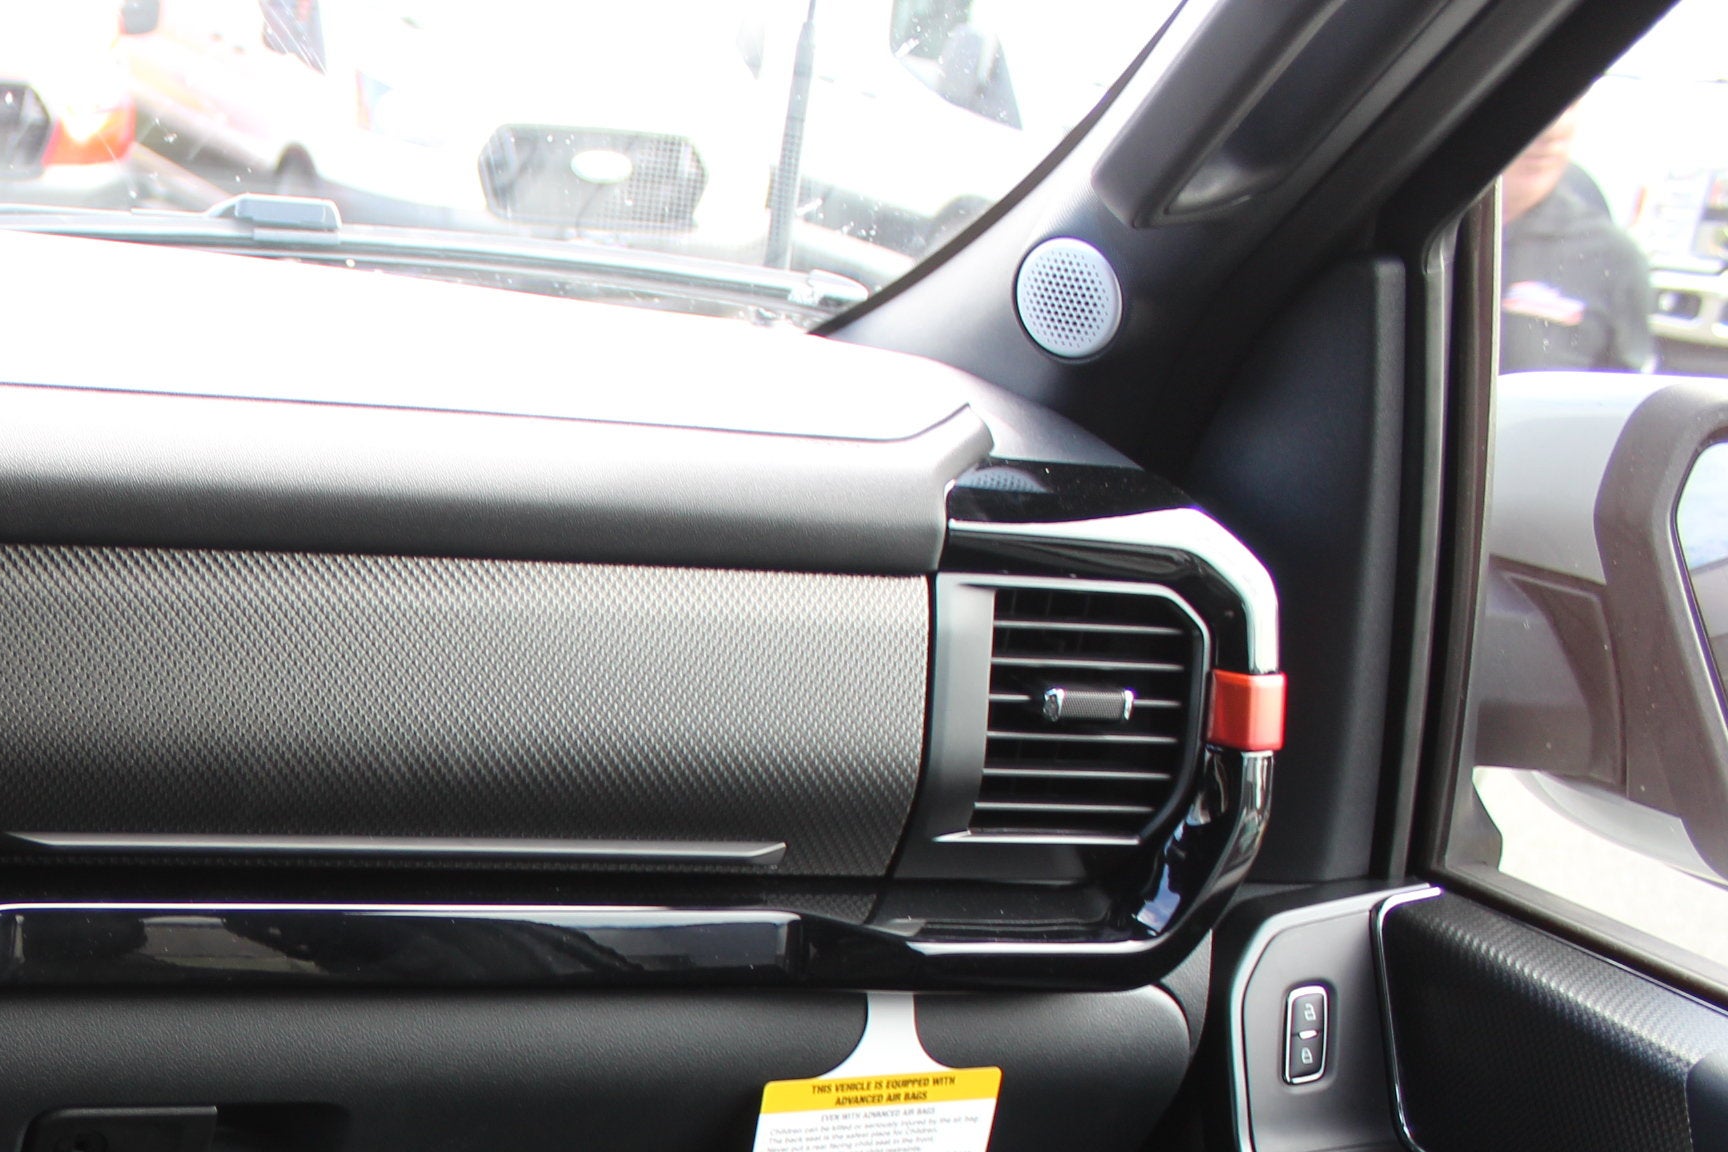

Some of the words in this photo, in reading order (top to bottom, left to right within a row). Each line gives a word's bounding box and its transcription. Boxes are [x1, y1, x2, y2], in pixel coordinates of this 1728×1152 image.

[812, 1085, 831, 1094] THIS
[835, 1082, 871, 1092] VEHICLE
[874, 1081, 883, 1090] IS
[886, 1079, 929, 1089] EQUIPPED
[933, 1077, 955, 1086] WITH
[835, 1094, 883, 1106] ADVANCED
[886, 1092, 901, 1102] AIR
[904, 1091, 927, 1100] BAGS
